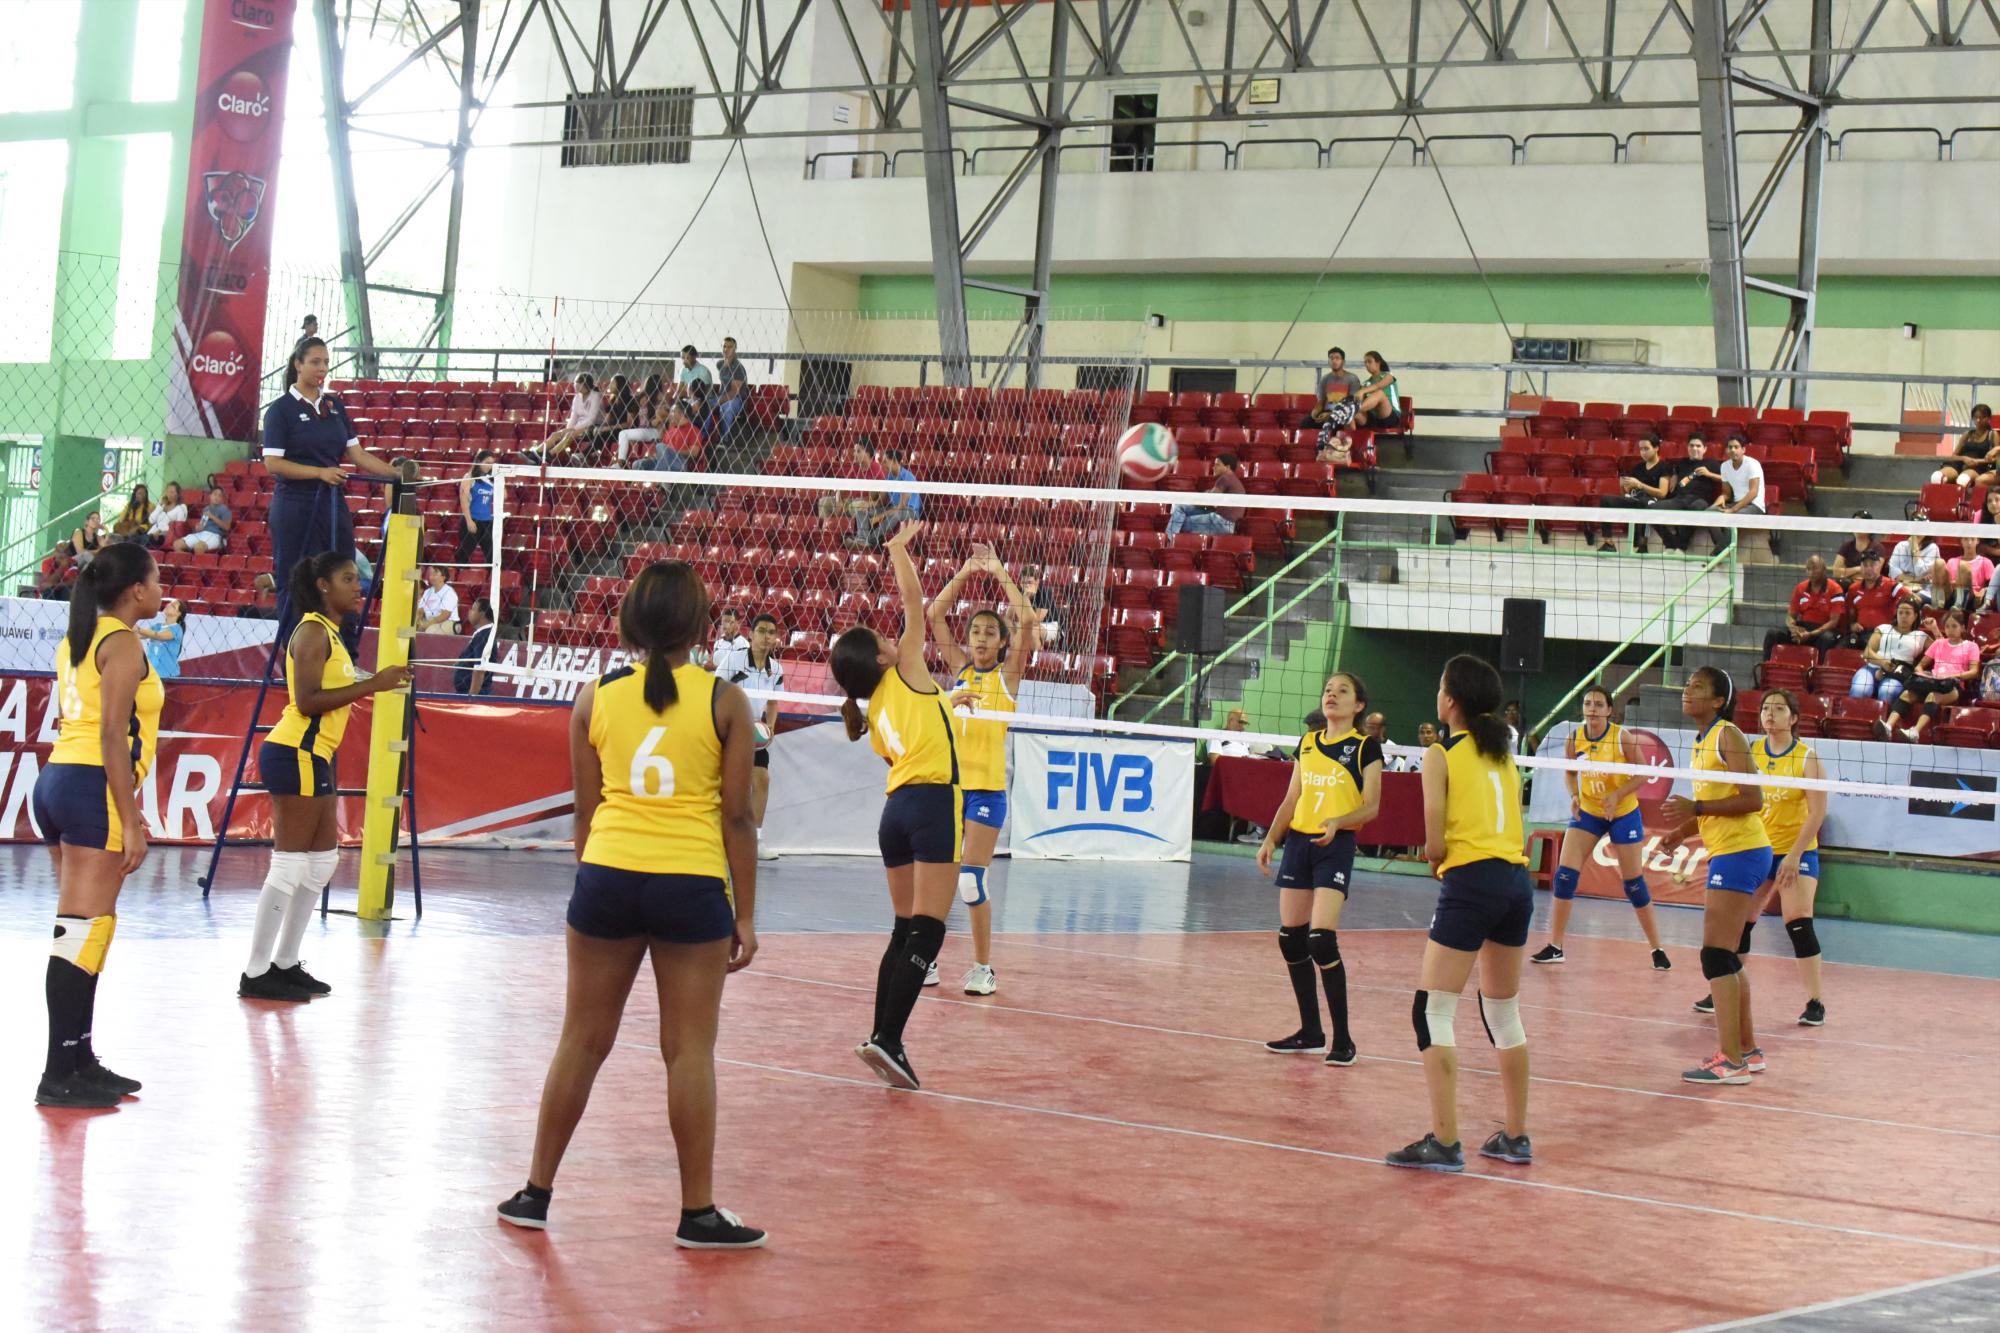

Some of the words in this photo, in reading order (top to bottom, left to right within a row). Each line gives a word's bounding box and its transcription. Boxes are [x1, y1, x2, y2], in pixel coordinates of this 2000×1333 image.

[218, 93, 265, 117] Claro
[192, 354, 240, 376] Claro
[527, 644, 601, 676] TAREA
[630, 726, 675, 798] 6
[1047, 751, 1153, 812] FIVB
[1302, 770, 1341, 787] Claro
[1313, 791, 1326, 815] 7
[1487, 770, 1505, 834] 1
[1592, 836, 1710, 877] Clar
